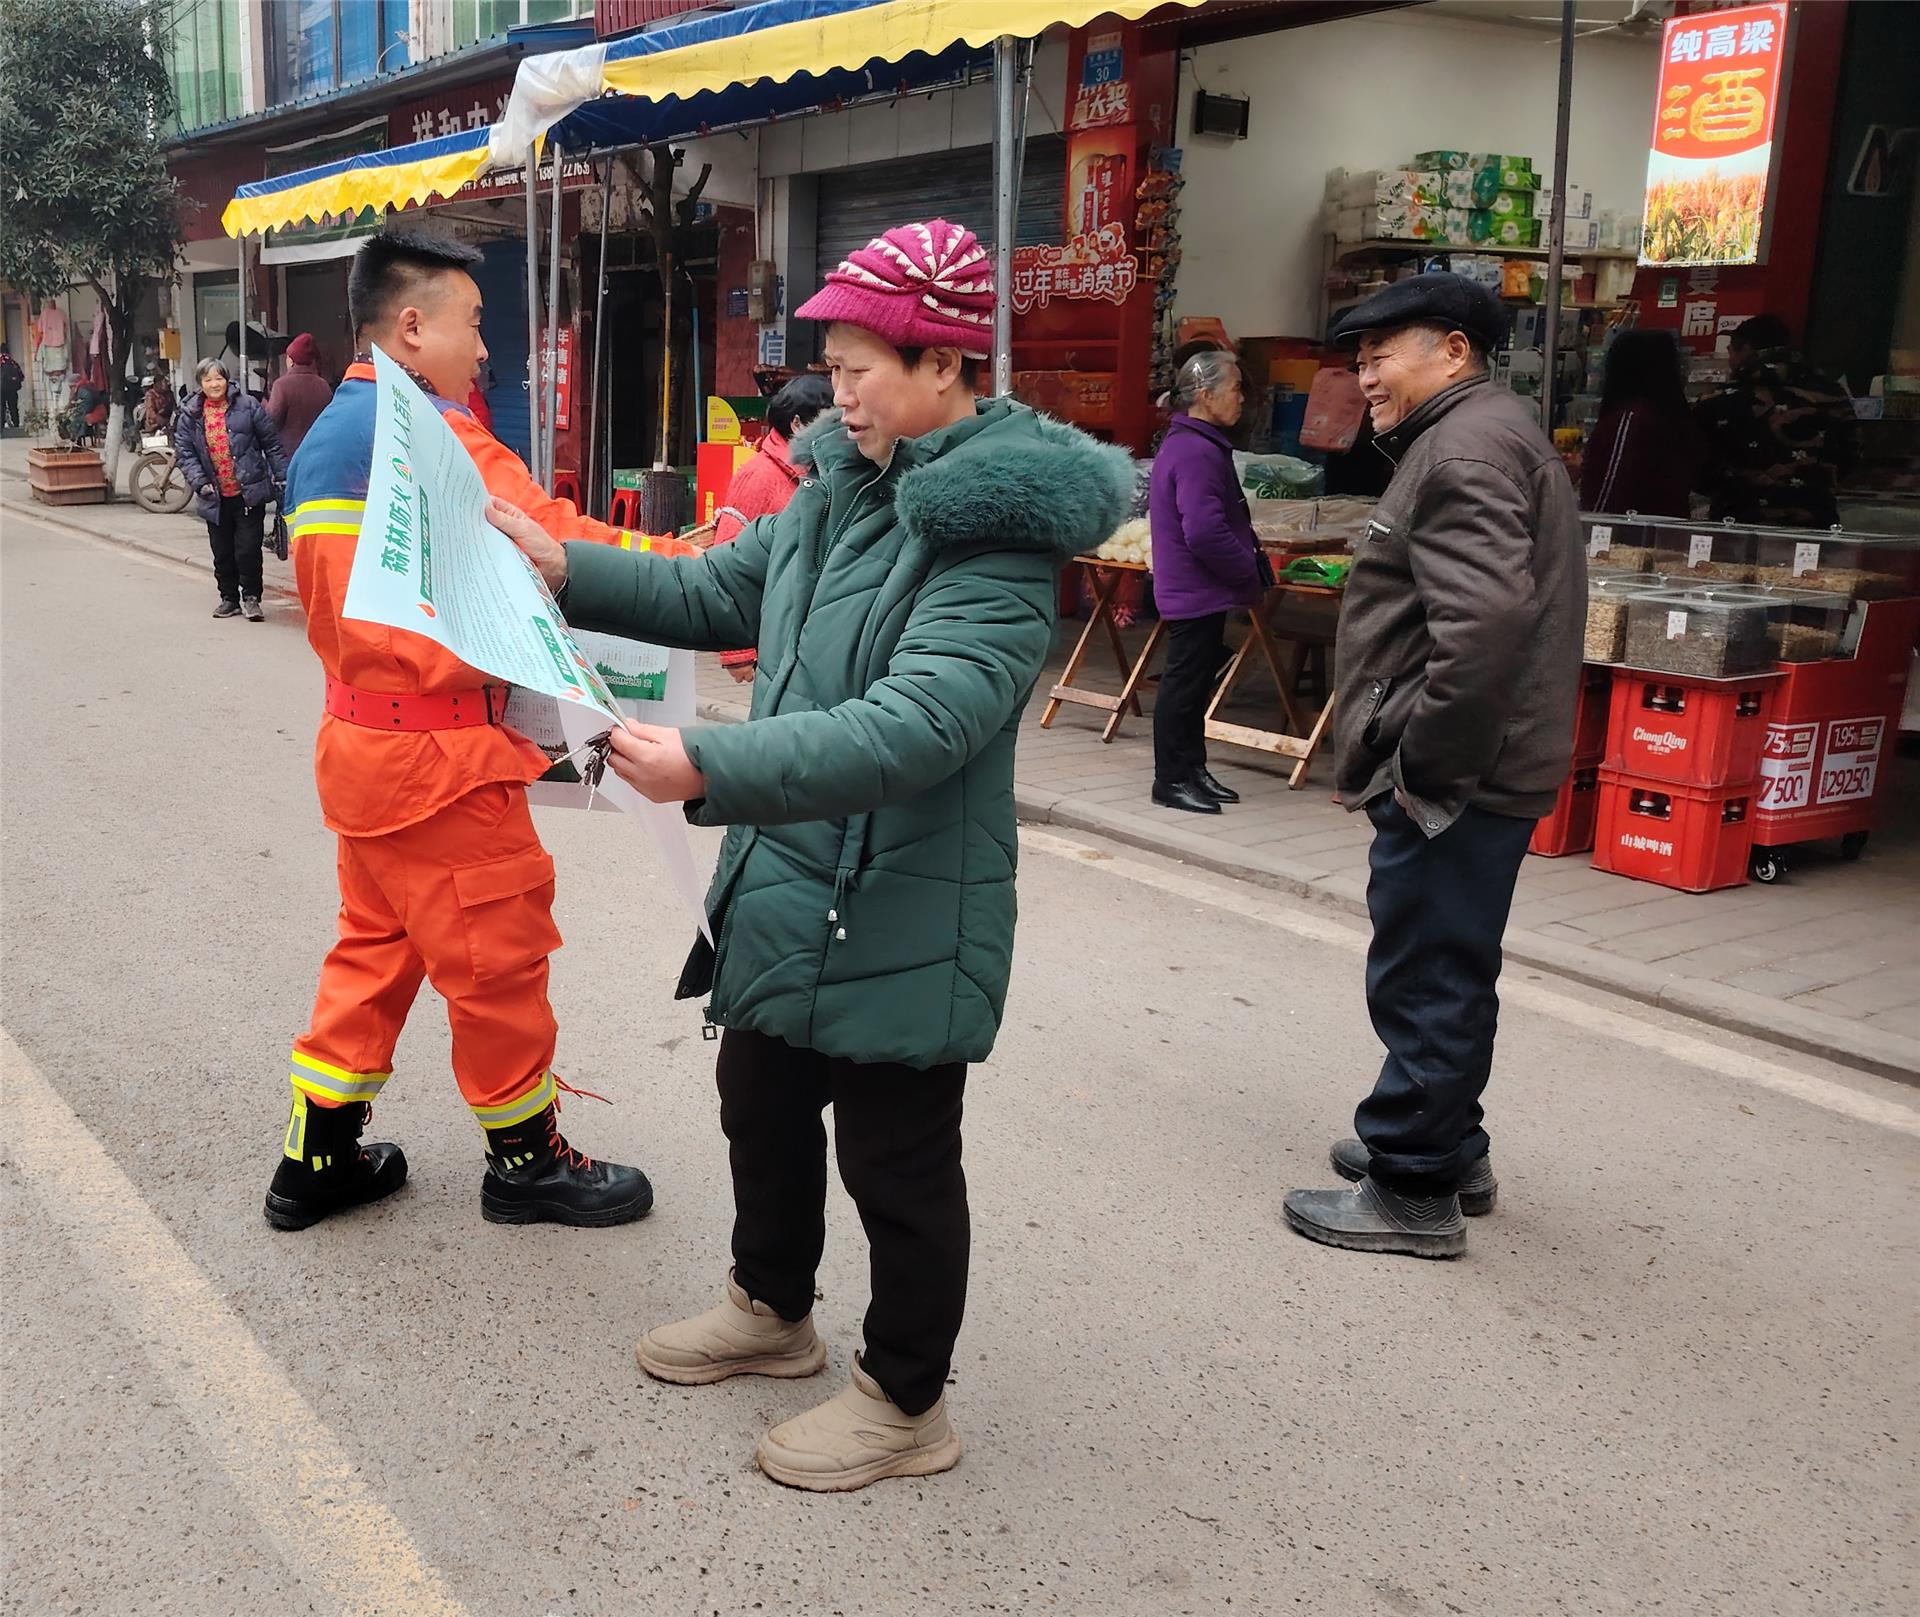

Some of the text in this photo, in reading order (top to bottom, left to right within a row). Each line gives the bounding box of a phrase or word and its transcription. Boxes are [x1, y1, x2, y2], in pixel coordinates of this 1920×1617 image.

[1095, 66, 1110, 82] 30
[412, 93, 510, 142] 祥和农
[1661, 67, 1766, 142] 酒
[1014, 267, 1053, 304] 过年
[1078, 260, 1134, 296] 消费节
[381, 383, 413, 577] 森林防火 人人有责
[1632, 726, 1687, 750] ChongQing
[1620, 833, 1674, 857] 山城啤酒
